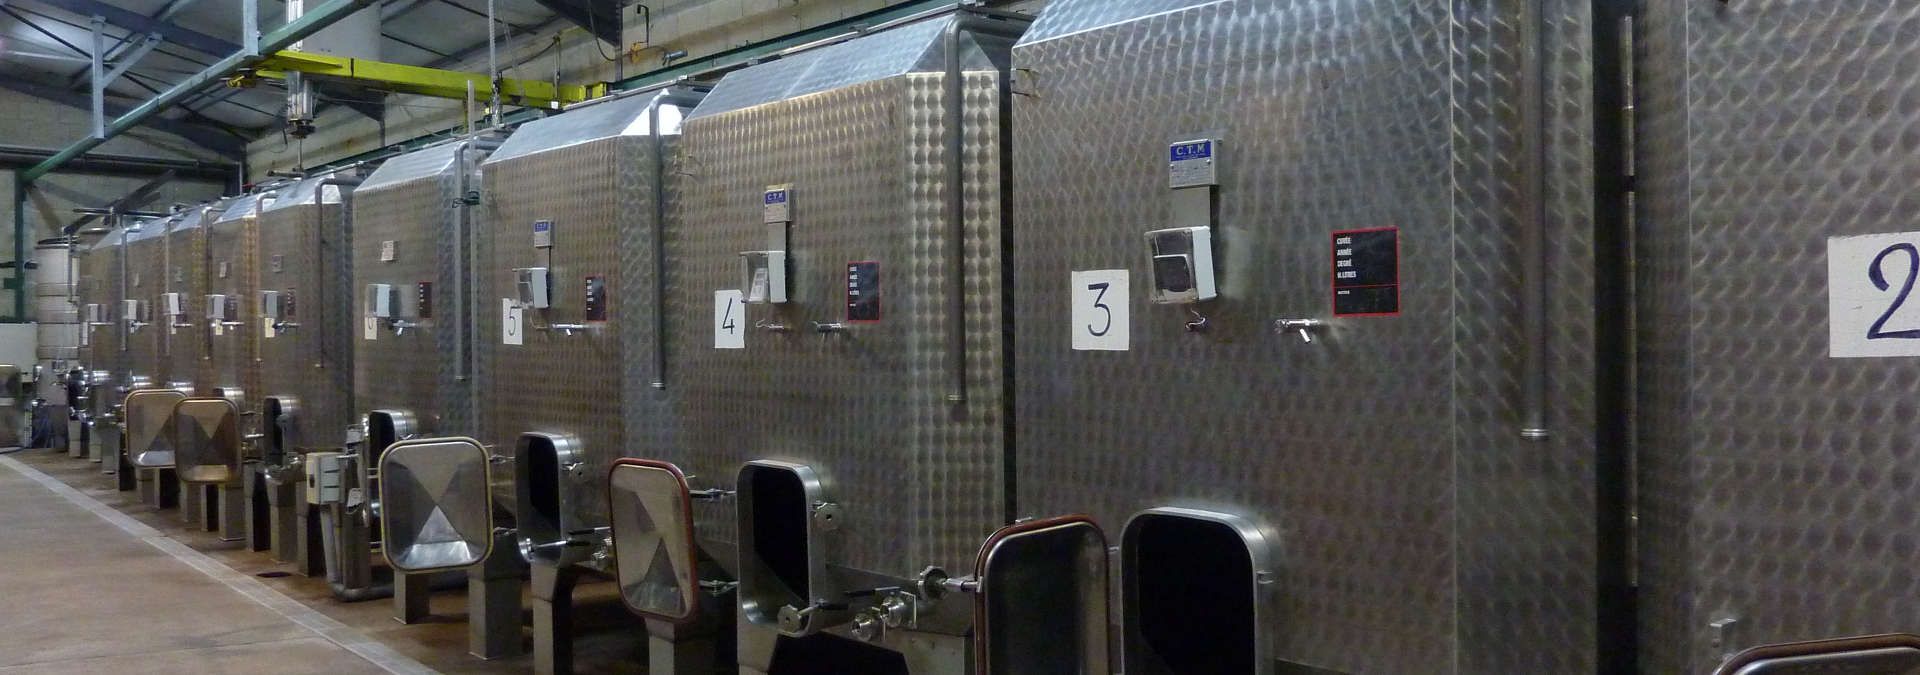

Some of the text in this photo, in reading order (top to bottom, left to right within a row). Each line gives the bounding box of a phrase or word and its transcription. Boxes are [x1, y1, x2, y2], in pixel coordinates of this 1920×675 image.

[1088, 282, 1111, 337] 3
[1867, 243, 1920, 339] 2
[508, 305, 521, 336] 5
[722, 298, 735, 335] 4
